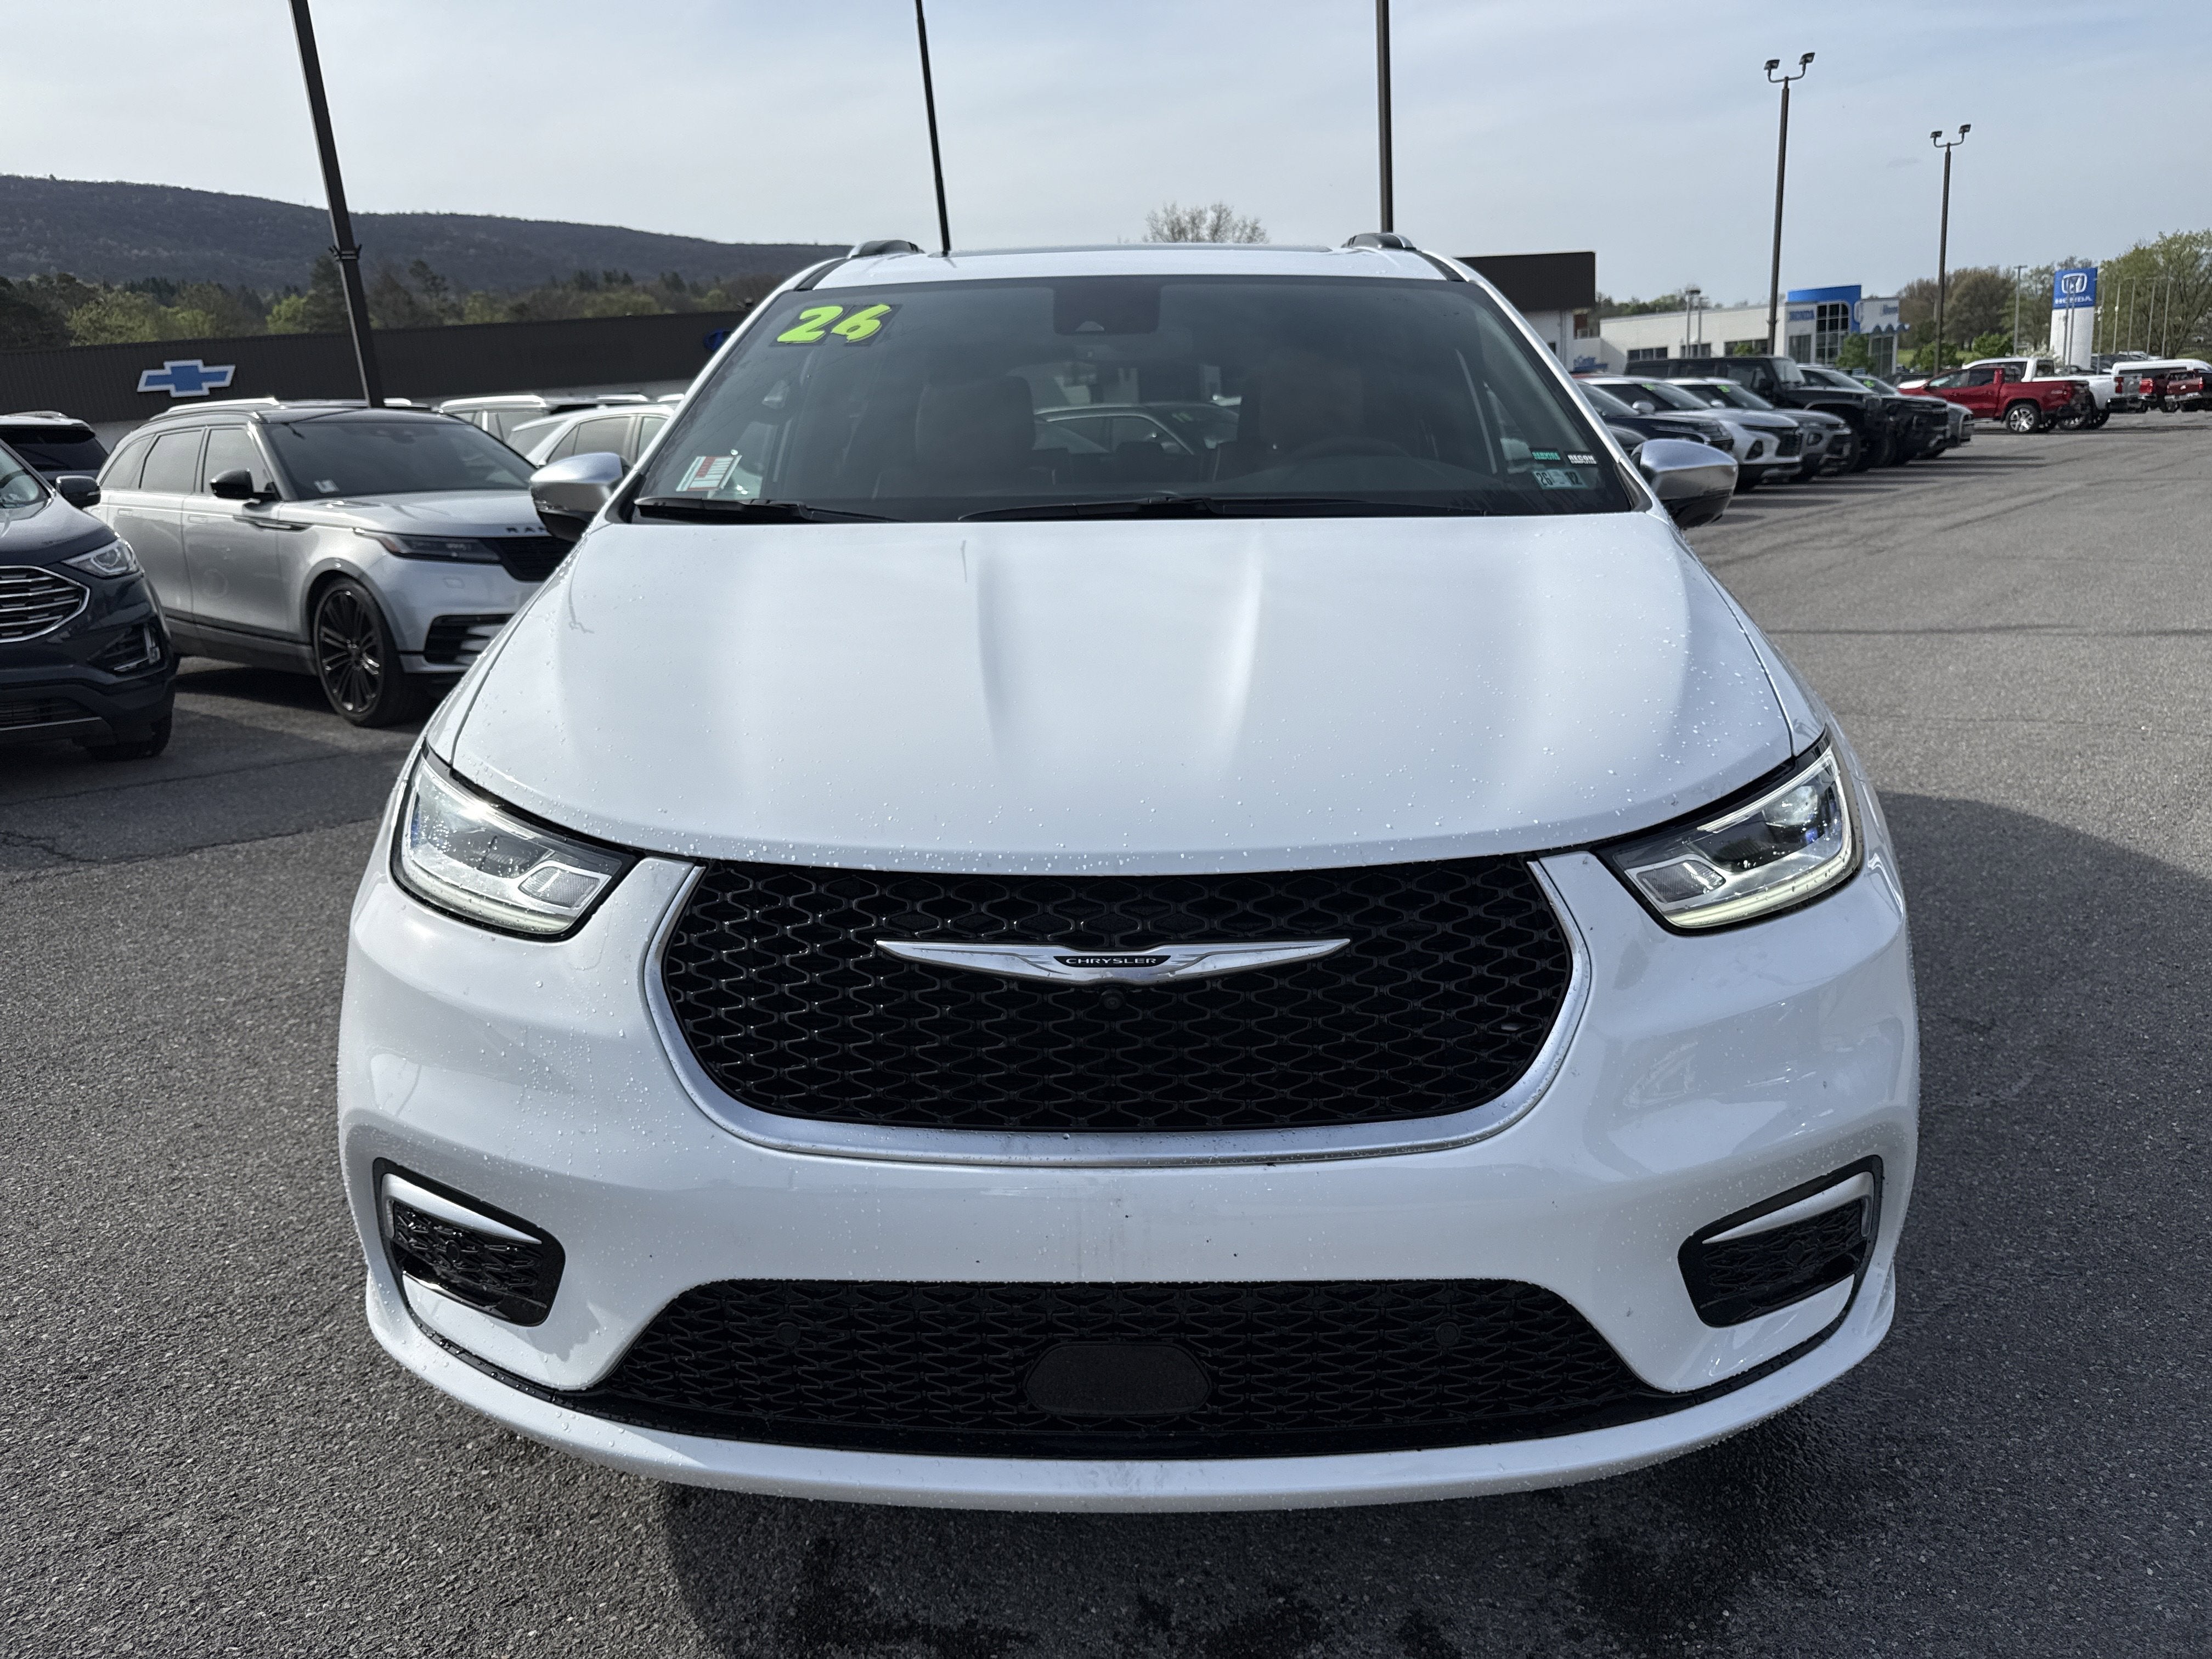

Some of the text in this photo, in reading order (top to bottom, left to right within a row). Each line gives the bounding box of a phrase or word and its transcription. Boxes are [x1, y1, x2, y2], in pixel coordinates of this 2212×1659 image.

[777, 304, 892, 342] 26
[1536, 472, 1553, 486] 26
[1565, 472, 1583, 485] 12
